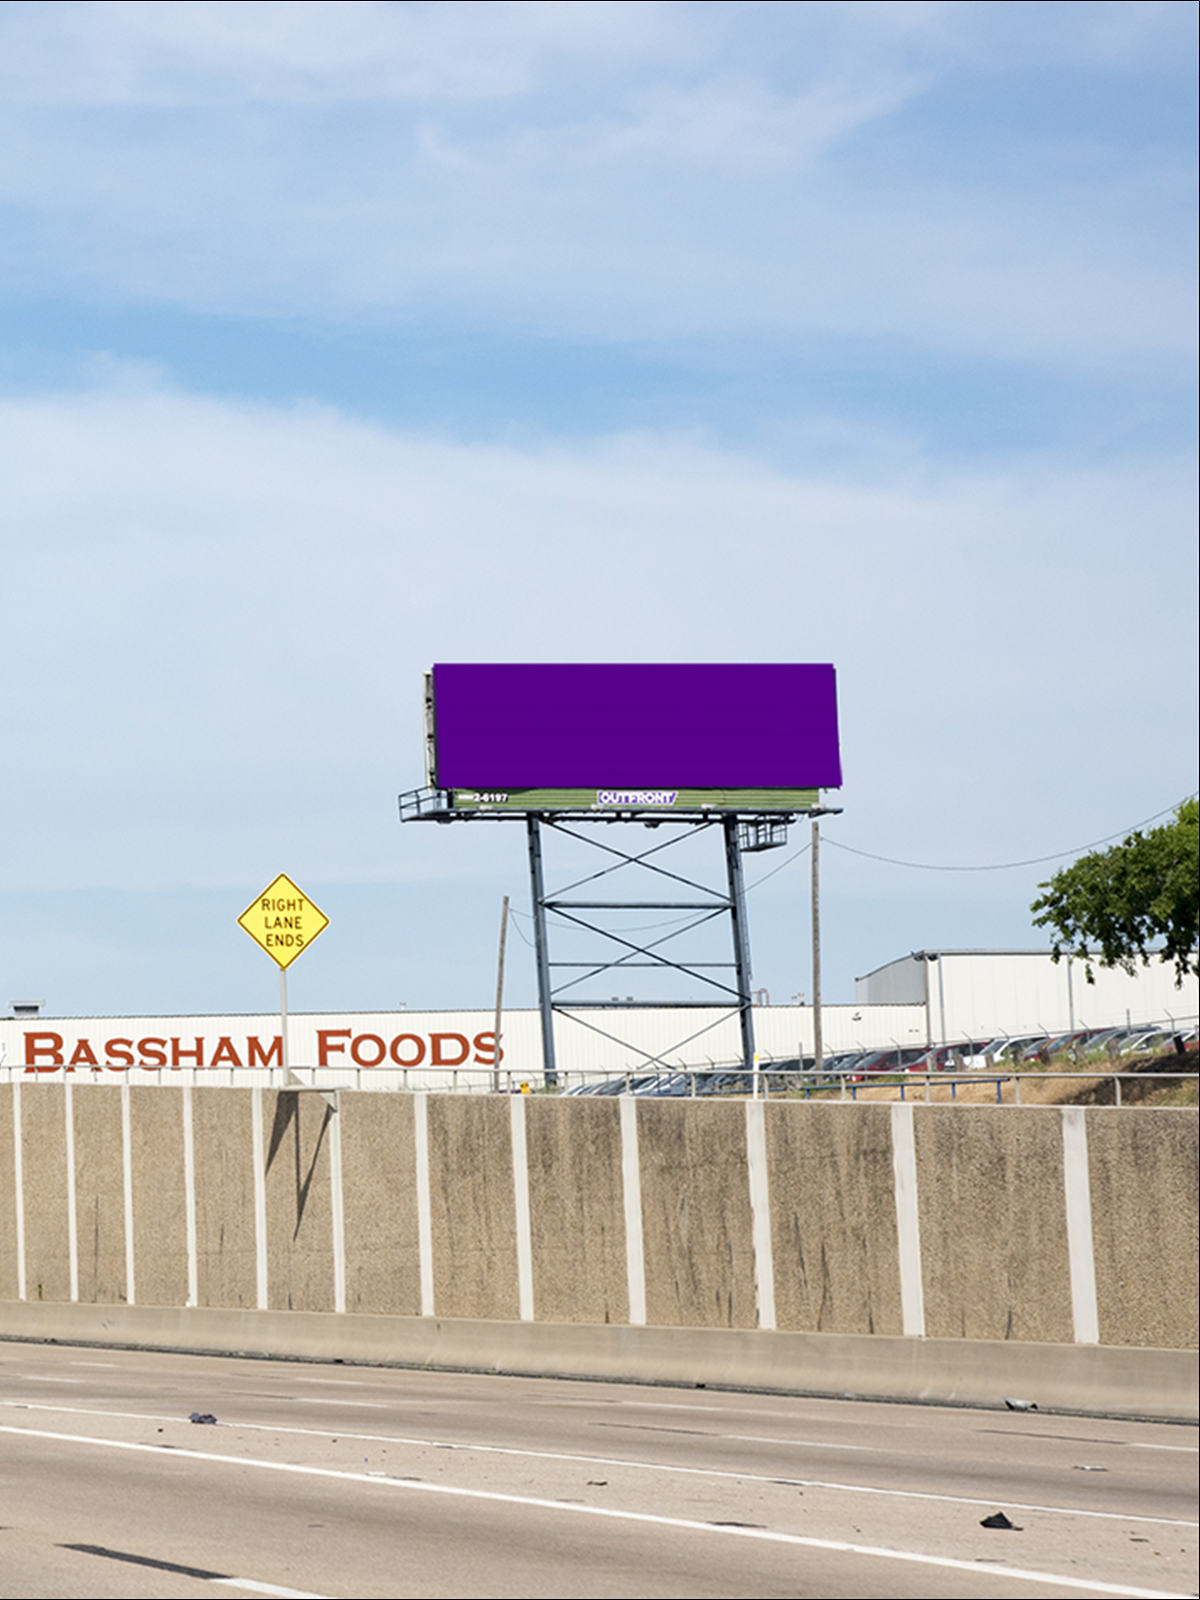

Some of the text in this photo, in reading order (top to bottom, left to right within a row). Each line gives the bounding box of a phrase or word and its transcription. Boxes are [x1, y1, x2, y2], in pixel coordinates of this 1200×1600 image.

[599, 791, 673, 805] OUTFRONT
[261, 898, 304, 912] RIGHT
[264, 916, 303, 930] LANE
[265, 933, 304, 948] ENDS
[22, 1028, 505, 1074] BASSHAM FOODS
